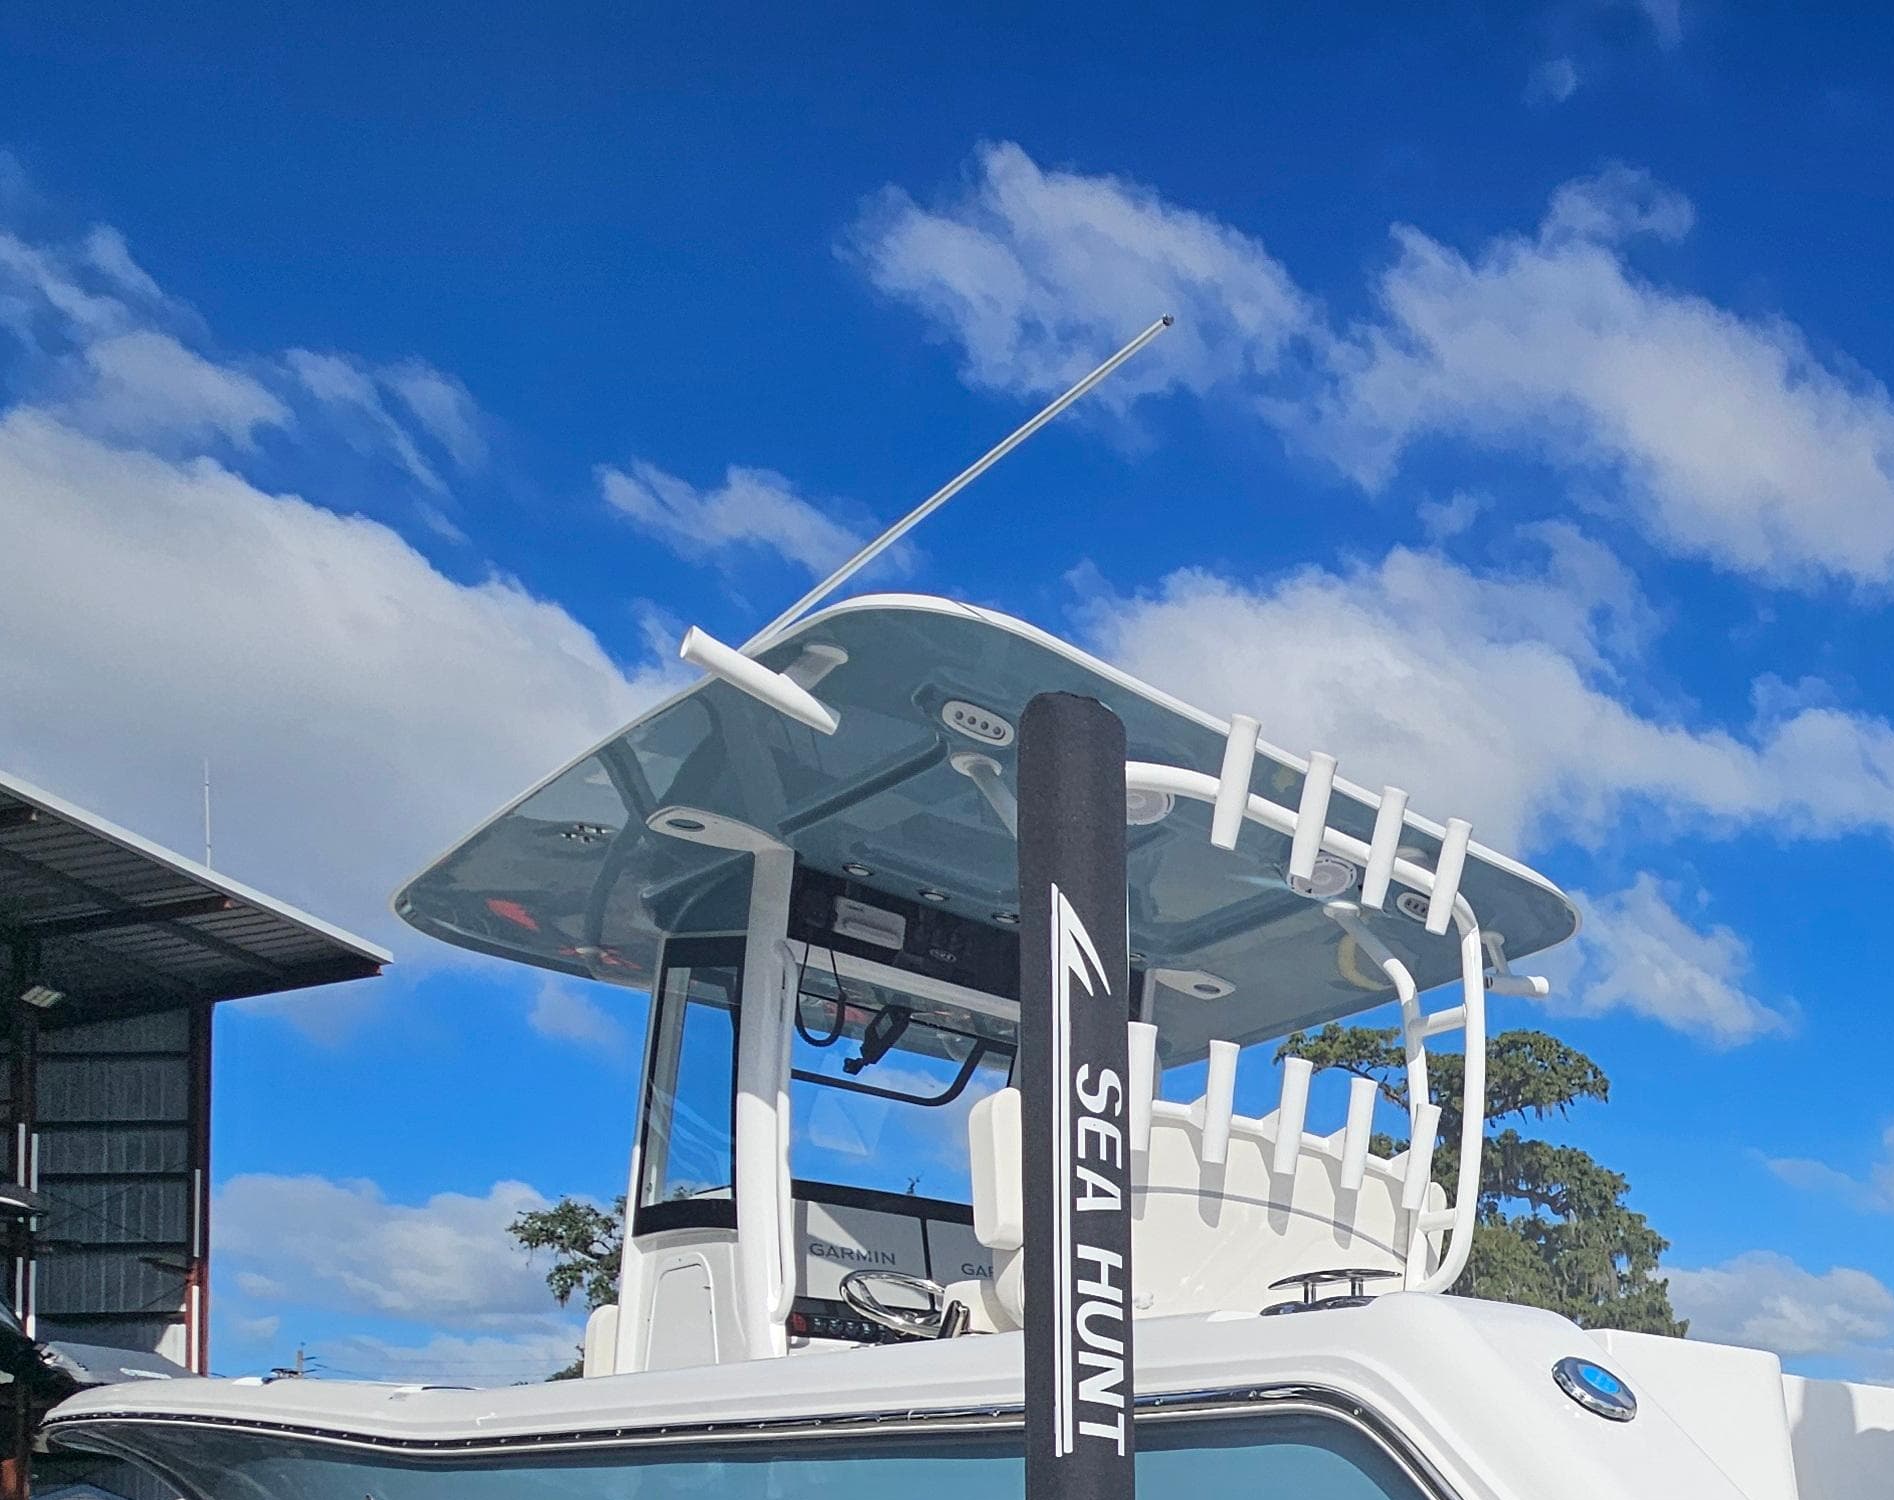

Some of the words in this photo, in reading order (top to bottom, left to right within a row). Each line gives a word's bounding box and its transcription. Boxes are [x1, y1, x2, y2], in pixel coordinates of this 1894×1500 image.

[1075, 1062, 1124, 1212] SEA
[809, 1242, 896, 1266] GARMIN
[1075, 1243, 1126, 1457] HUNT
